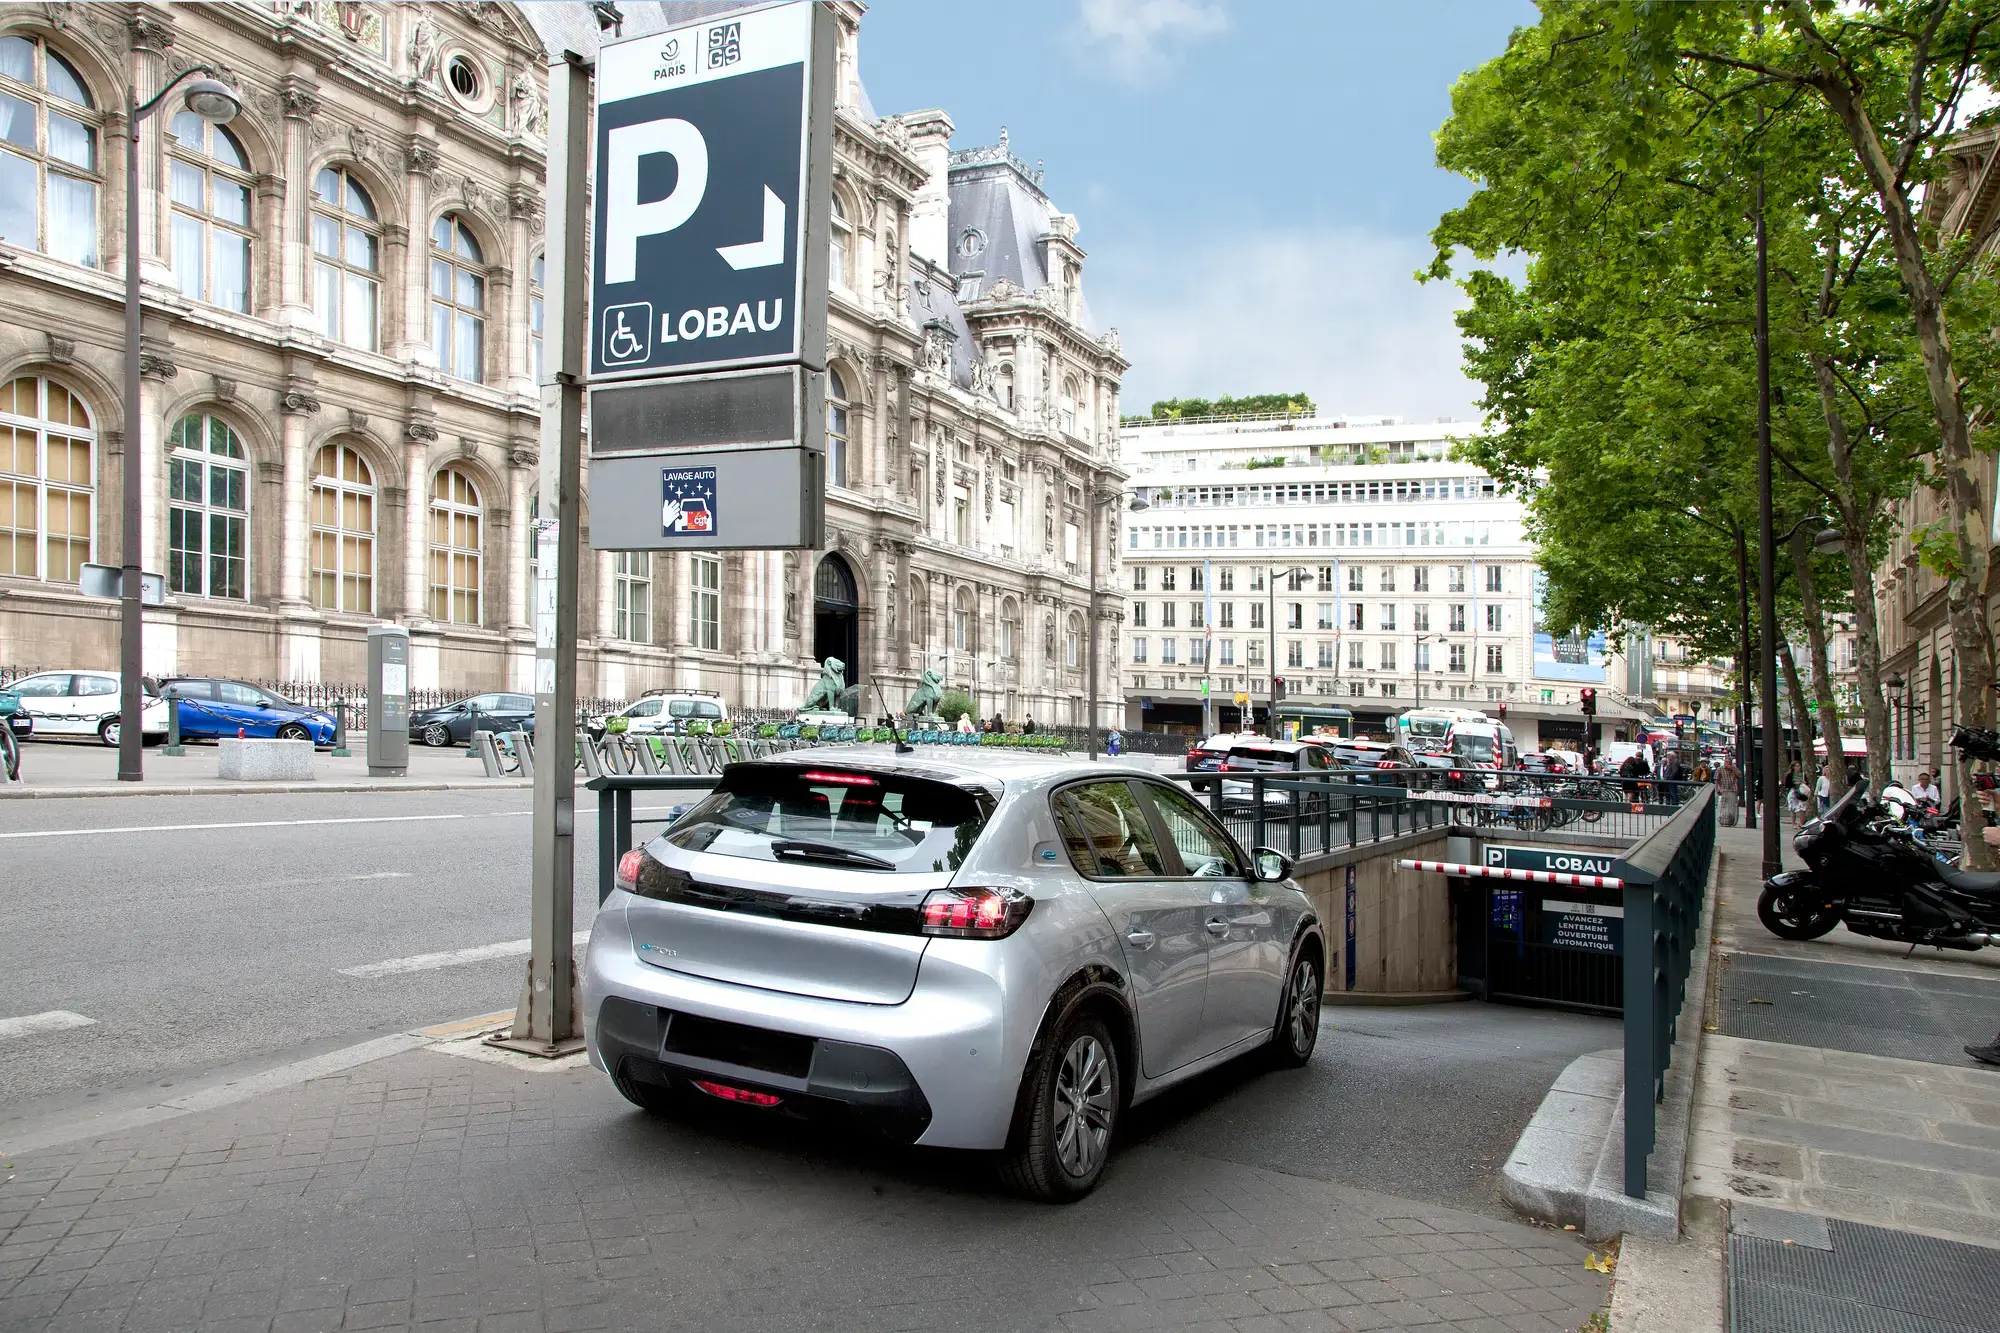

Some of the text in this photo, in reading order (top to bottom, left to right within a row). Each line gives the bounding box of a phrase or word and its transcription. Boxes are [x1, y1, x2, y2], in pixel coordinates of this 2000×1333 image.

[654, 64, 686, 80] PARIS
[605, 118, 709, 285] P
[660, 298, 783, 344] LOBAU
[664, 471, 715, 481] LAVAGE AUTO
[1408, 791, 1454, 801] HAUTEUR
[1489, 850, 1611, 873] P LOBAU
[1563, 915, 1603, 924] AVANCEZ
[1558, 922, 1608, 933] LENTEMENT
[1557, 930, 1609, 941] OUVERTURE
[1553, 938, 1614, 950] AUTOMATIQUE
